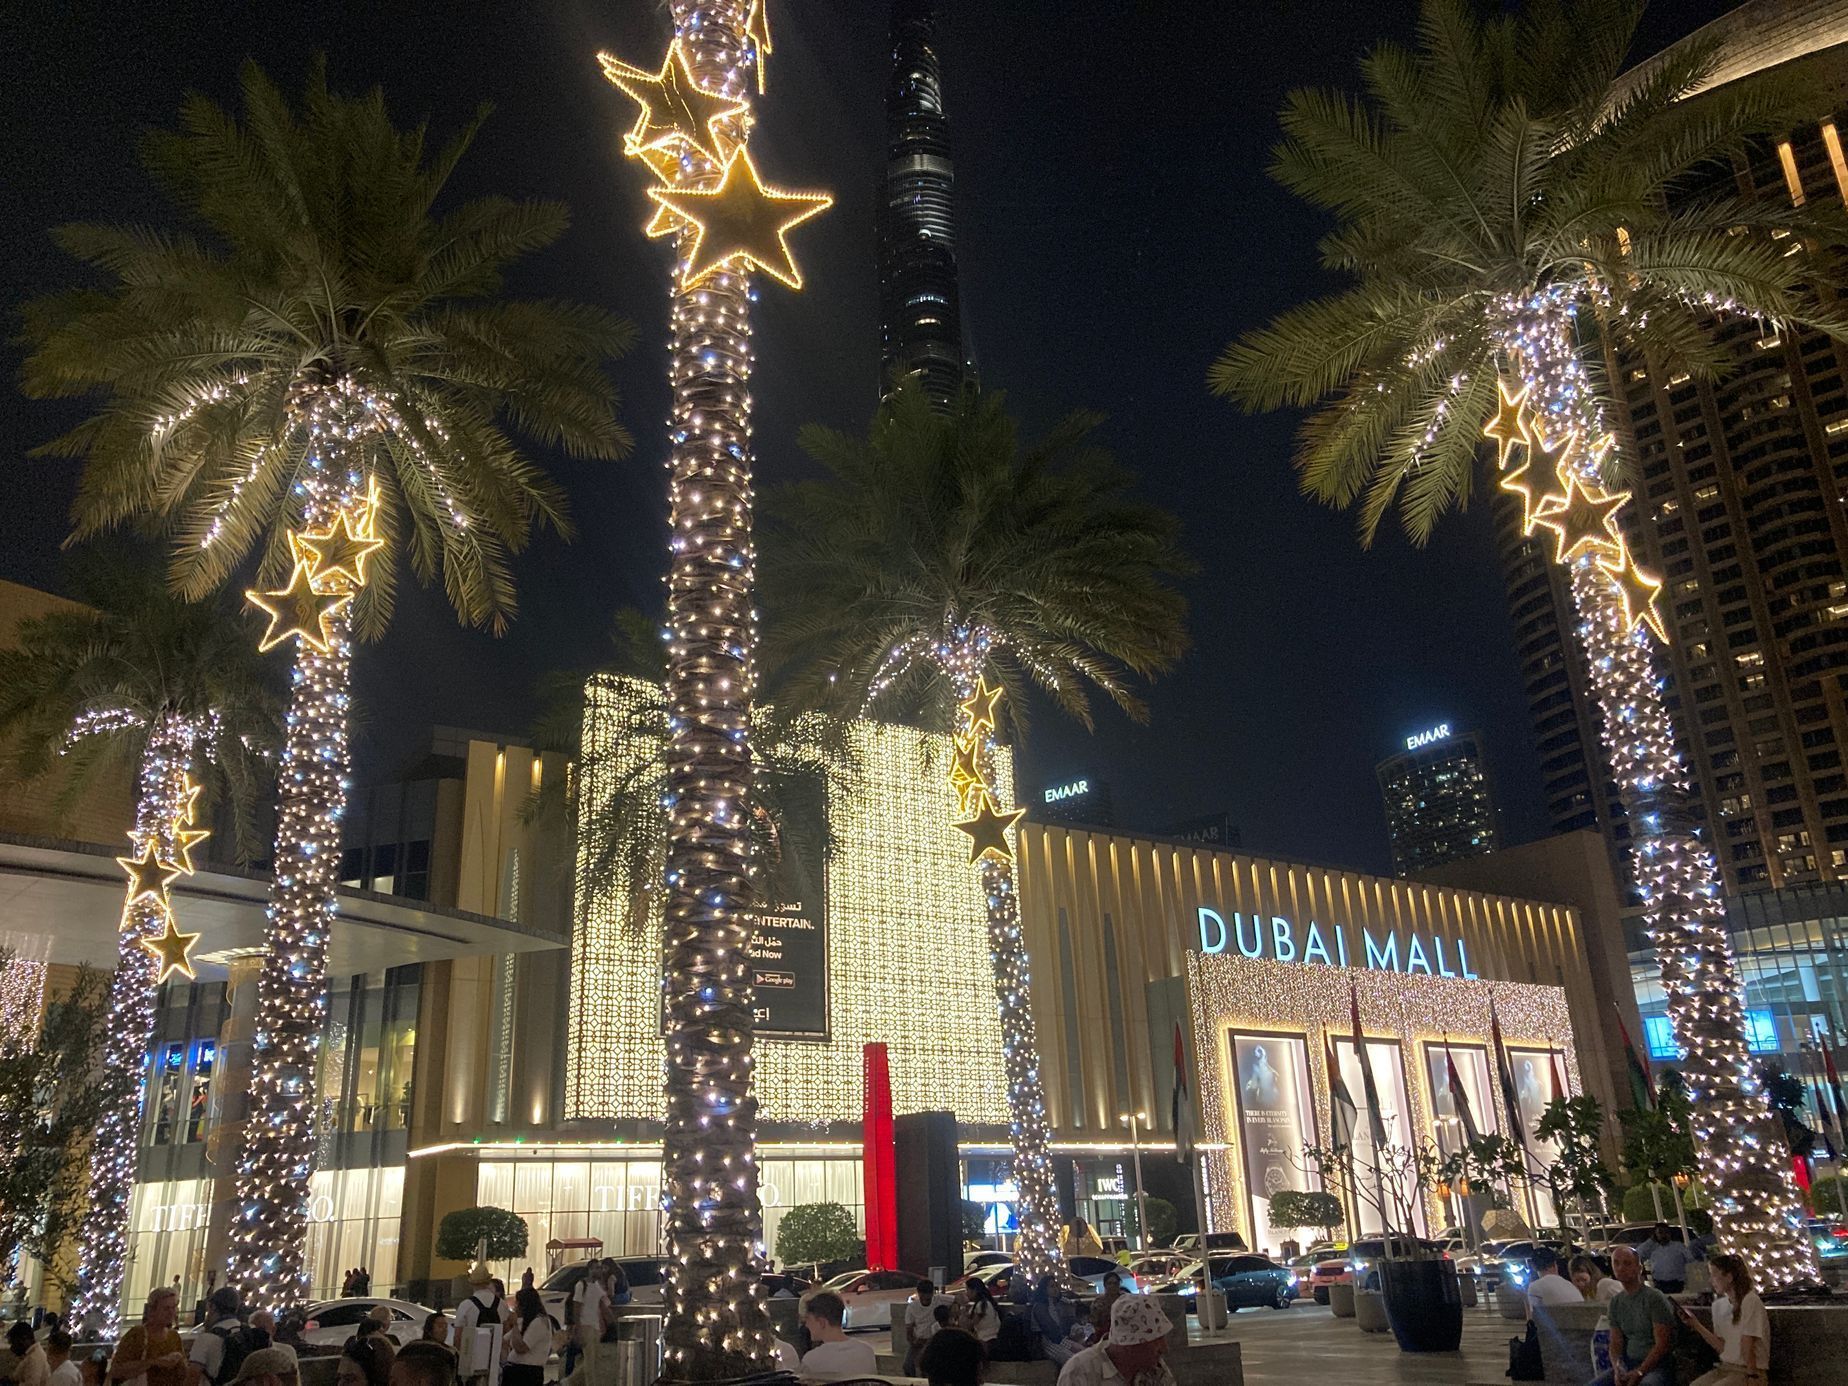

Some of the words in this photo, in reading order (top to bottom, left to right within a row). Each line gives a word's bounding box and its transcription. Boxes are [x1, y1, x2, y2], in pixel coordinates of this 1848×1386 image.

[1407, 724, 1450, 750] EMAAR
[1044, 780, 1089, 803] EMAAR
[762, 949, 782, 960] Now
[1197, 907, 1346, 968] DUBAI
[1363, 926, 1478, 980] MALL
[1097, 1178, 1121, 1192] IWC
